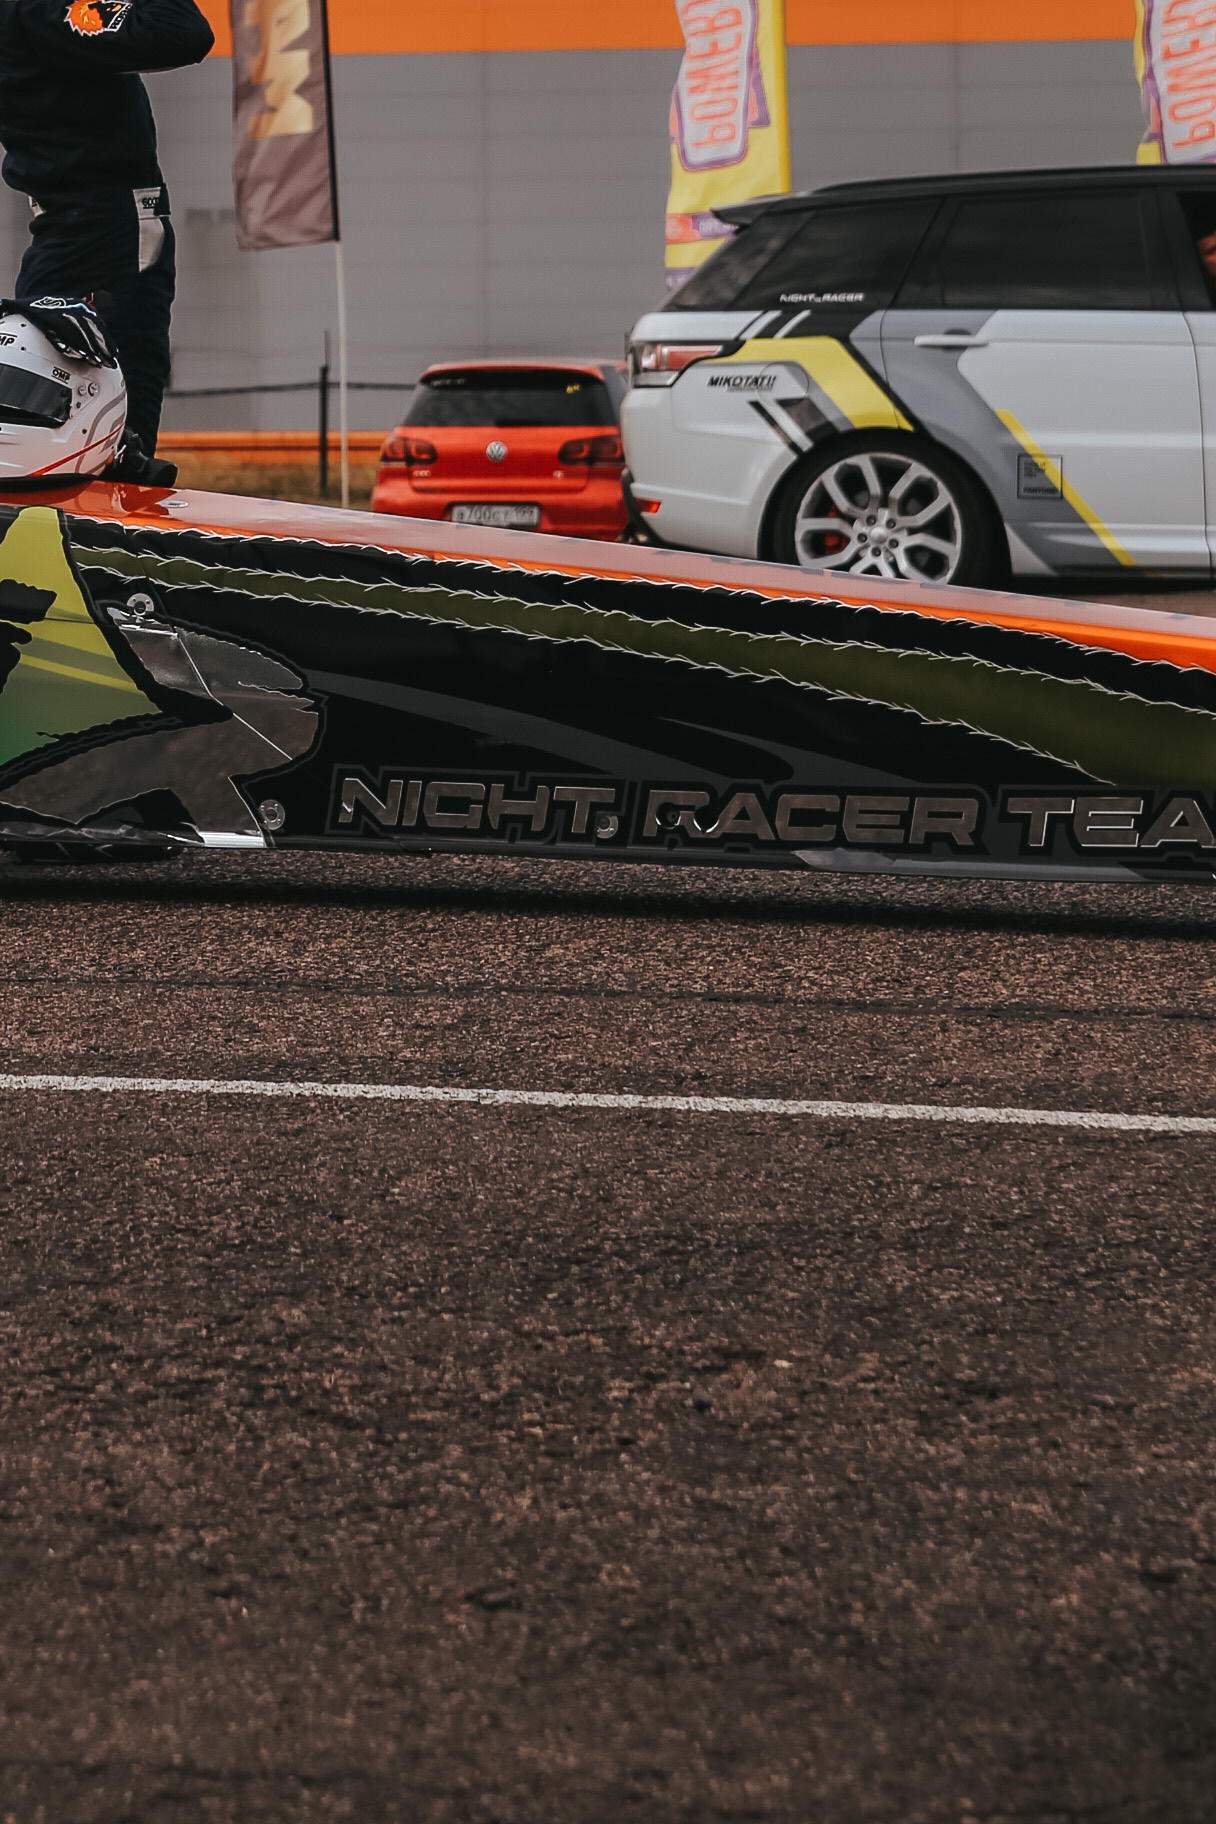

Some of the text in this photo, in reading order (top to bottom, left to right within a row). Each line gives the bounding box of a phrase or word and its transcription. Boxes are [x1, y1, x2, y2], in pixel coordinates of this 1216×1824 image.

[338, 778, 1216, 849] NIGHT RACER TEA
